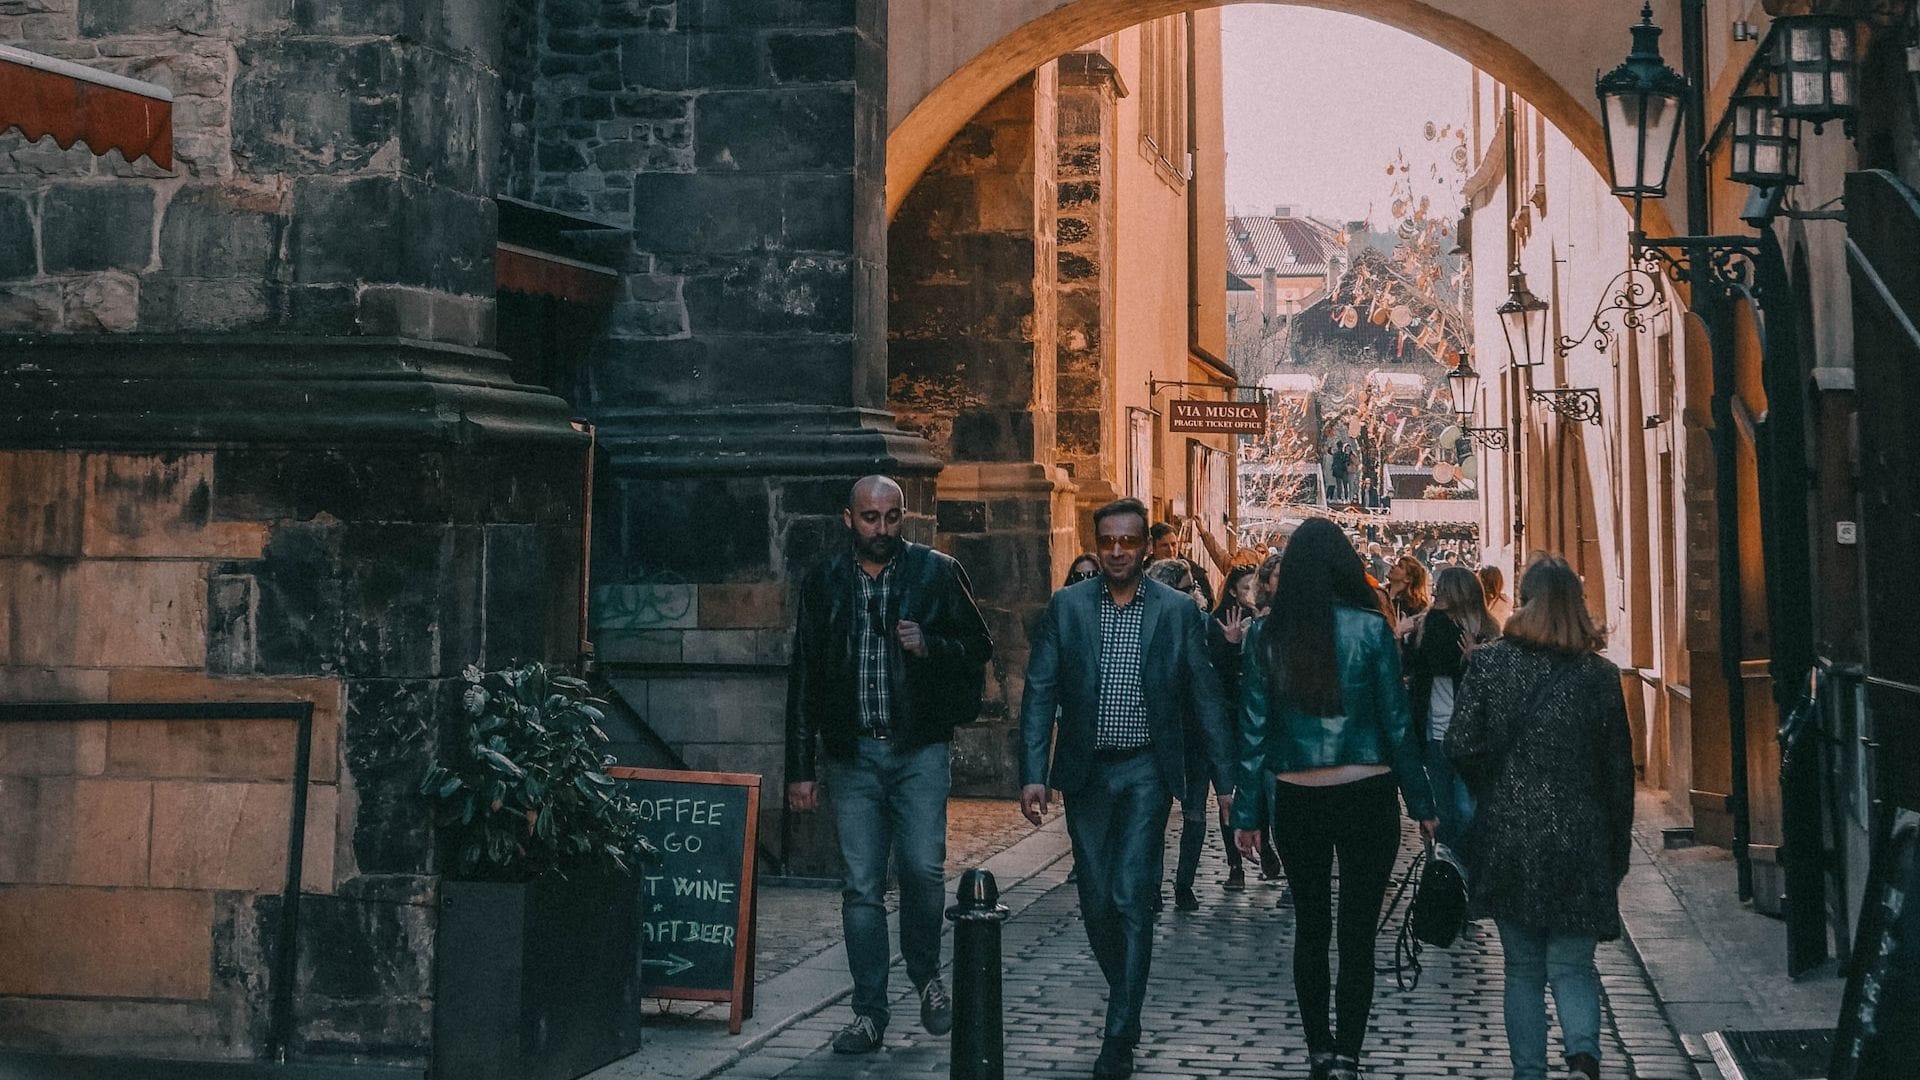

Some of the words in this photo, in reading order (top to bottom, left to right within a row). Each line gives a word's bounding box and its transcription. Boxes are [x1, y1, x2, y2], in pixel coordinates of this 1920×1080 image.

[1177, 405, 1201, 417] VIA
[1205, 406, 1259, 419] MUSICA
[1174, 419, 1204, 427] PRAGUE
[1205, 420, 1233, 429] TICKET
[1234, 421, 1262, 429] OFFICE
[638, 798, 726, 826] OFFEE
[663, 831, 702, 853] GO
[642, 919, 684, 943] AFT
[682, 920, 735, 948] BEER
